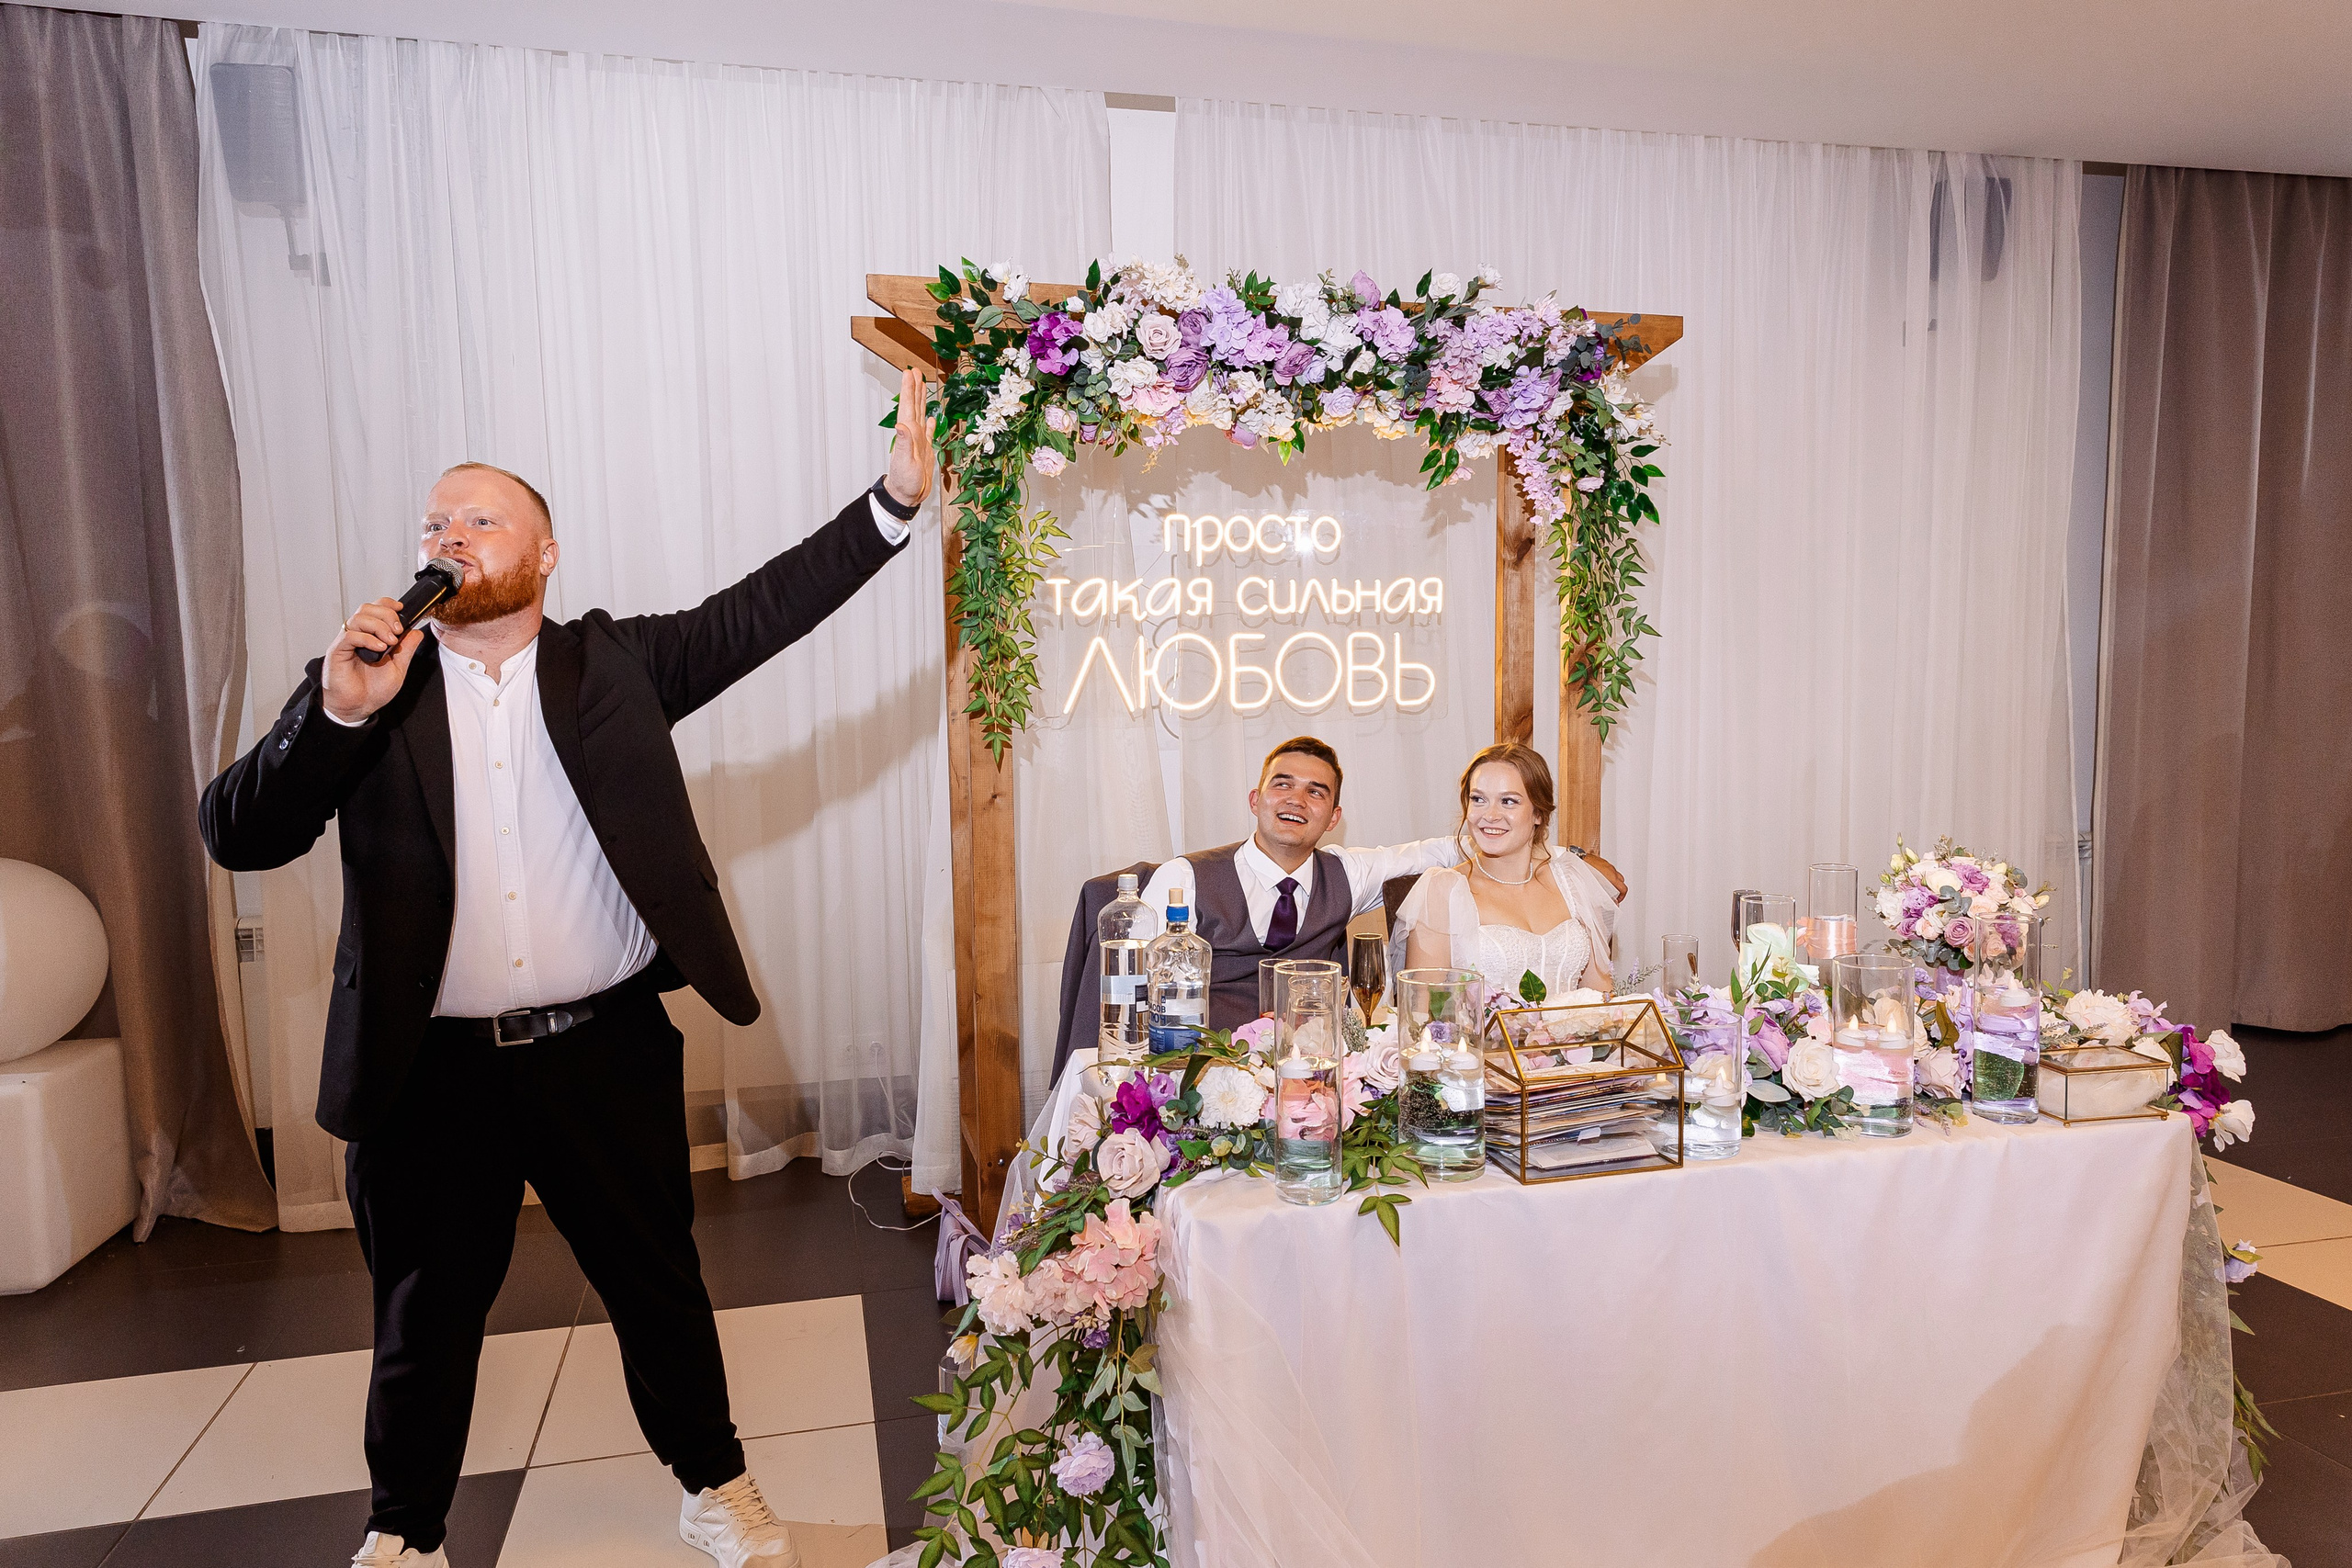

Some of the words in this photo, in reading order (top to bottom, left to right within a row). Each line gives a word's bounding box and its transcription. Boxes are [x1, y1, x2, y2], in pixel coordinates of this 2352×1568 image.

[1164, 513, 1342, 567] просто
[1046, 577, 1214, 622] такая
[1236, 576, 1444, 615] сильная
[1062, 631, 1436, 715] ЛЮБОВЬ
